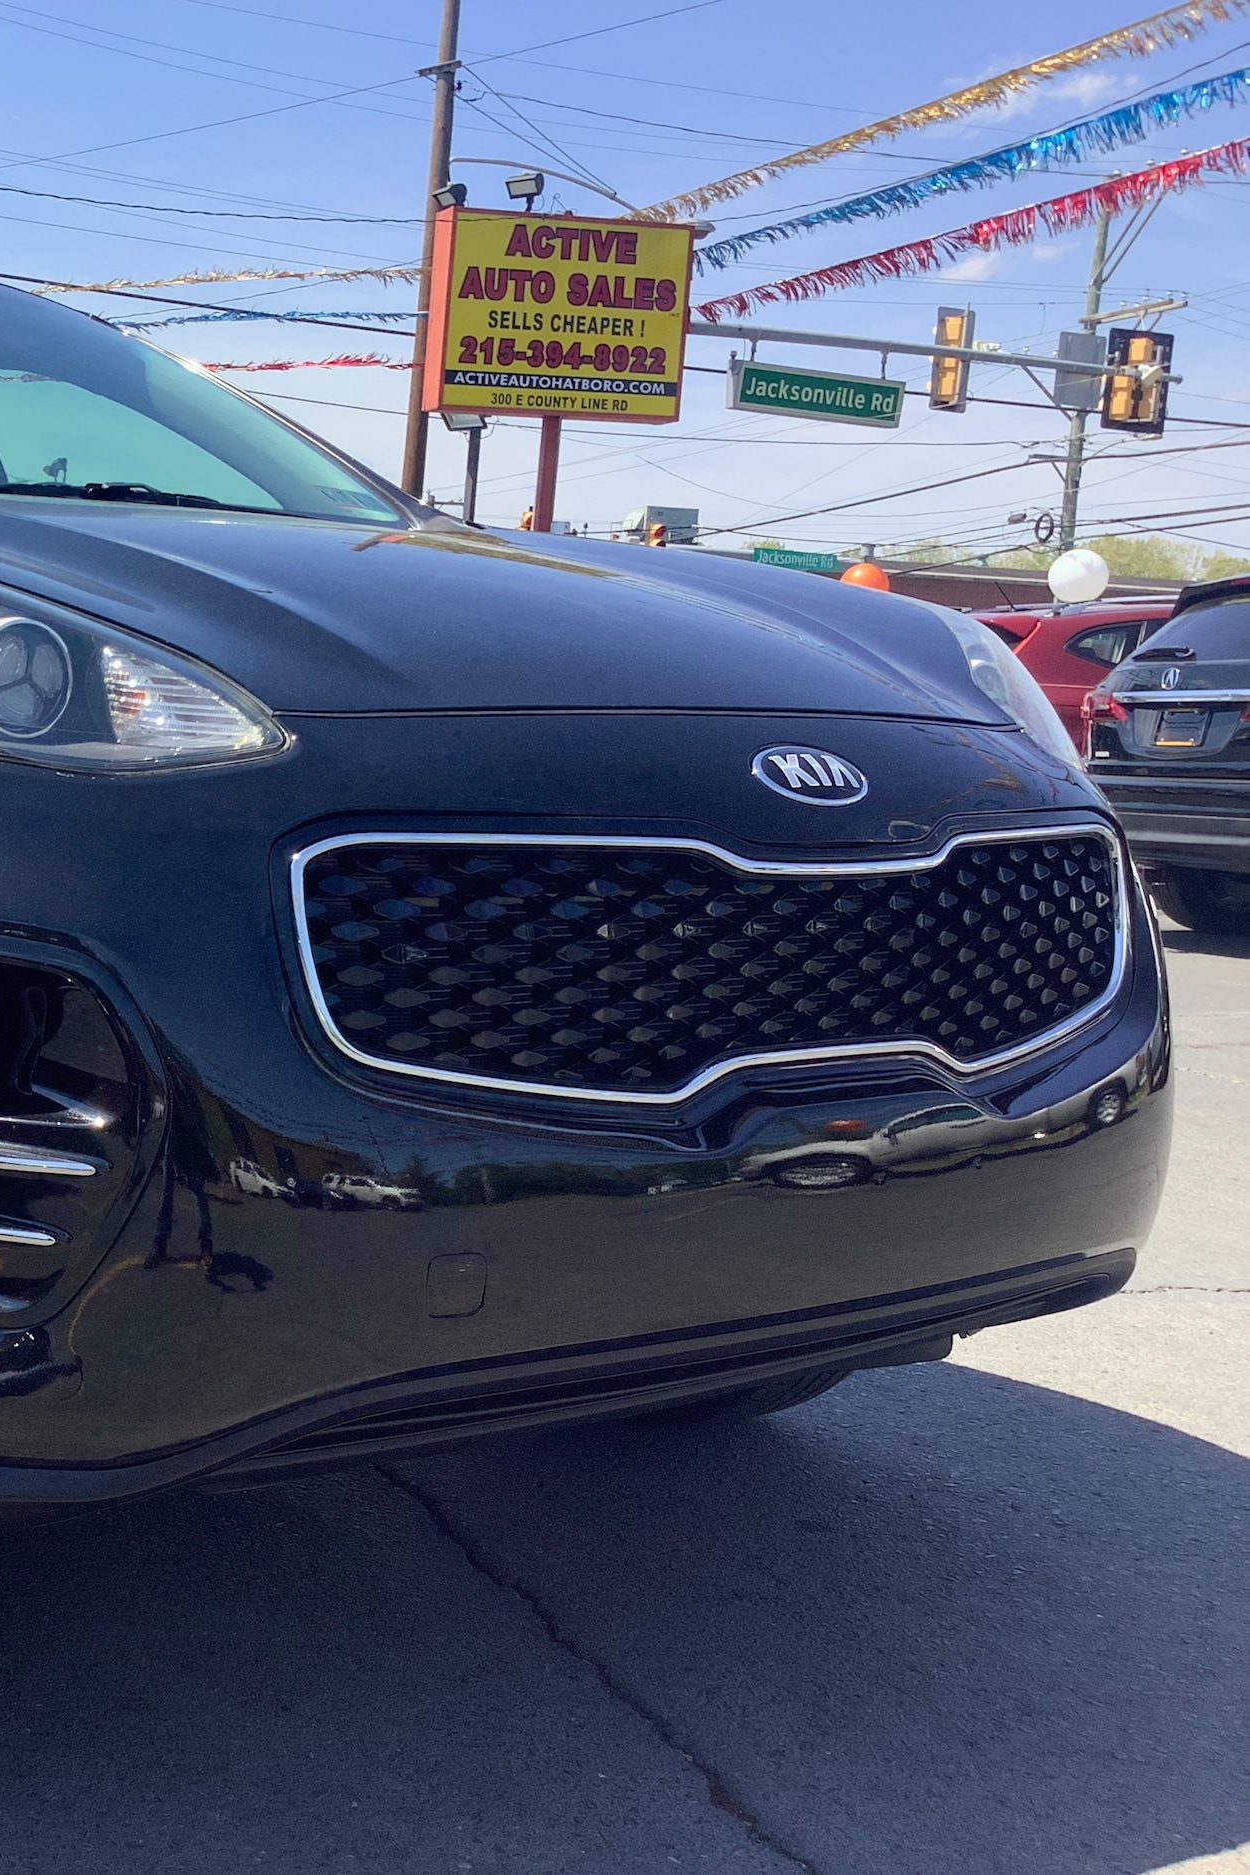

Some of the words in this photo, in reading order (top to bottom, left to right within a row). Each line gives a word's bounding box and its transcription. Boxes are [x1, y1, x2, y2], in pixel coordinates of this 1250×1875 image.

[505, 224, 638, 265] ACTIVE
[458, 266, 556, 304] AUTO
[566, 273, 677, 312] SALES
[488, 310, 544, 332] SELLS
[550, 314, 634, 337] CHEAPER
[458, 335, 666, 375] 215-394-8922
[453, 371, 665, 395] ACTIVEAUTOHATBORO.COM
[745, 377, 866, 410] Jacksonville
[870, 392, 895, 413] Rd
[491, 393, 512, 406] 300
[516, 394, 523, 406] E
[527, 395, 576, 409] COUNTY
[581, 397, 608, 410] LINE
[612, 398, 628, 411] RD
[757, 550, 818, 568] Jacksonville
[820, 555, 834, 568] Rd
[768, 753, 860, 788] KIA
